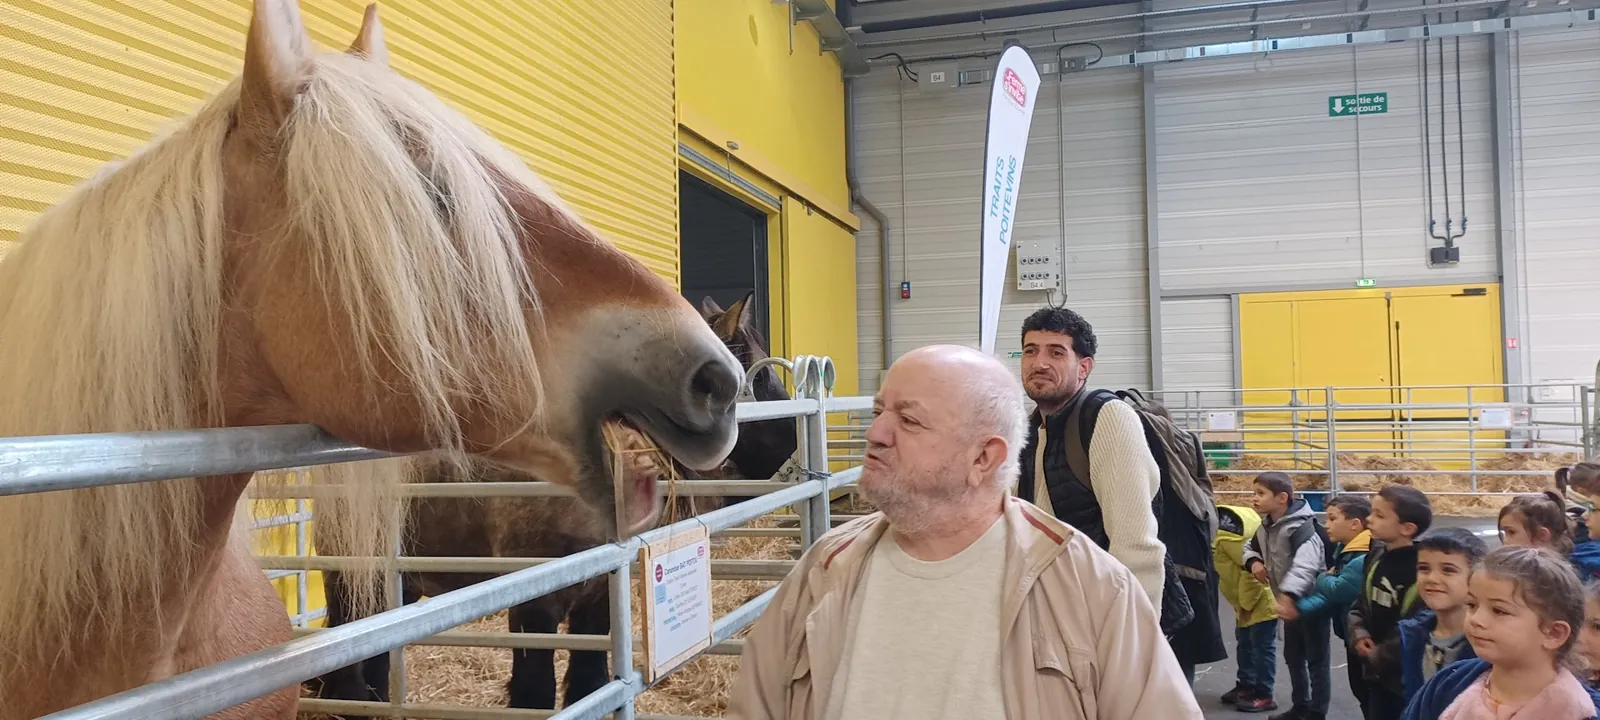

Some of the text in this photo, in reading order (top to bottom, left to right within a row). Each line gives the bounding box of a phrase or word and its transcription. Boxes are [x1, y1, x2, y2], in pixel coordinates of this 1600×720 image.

[1346, 96, 1371, 105] sortie
[1348, 104, 1382, 113] secours
[990, 156, 1004, 218] TRAITS
[999, 155, 1016, 245] POITEVINS
